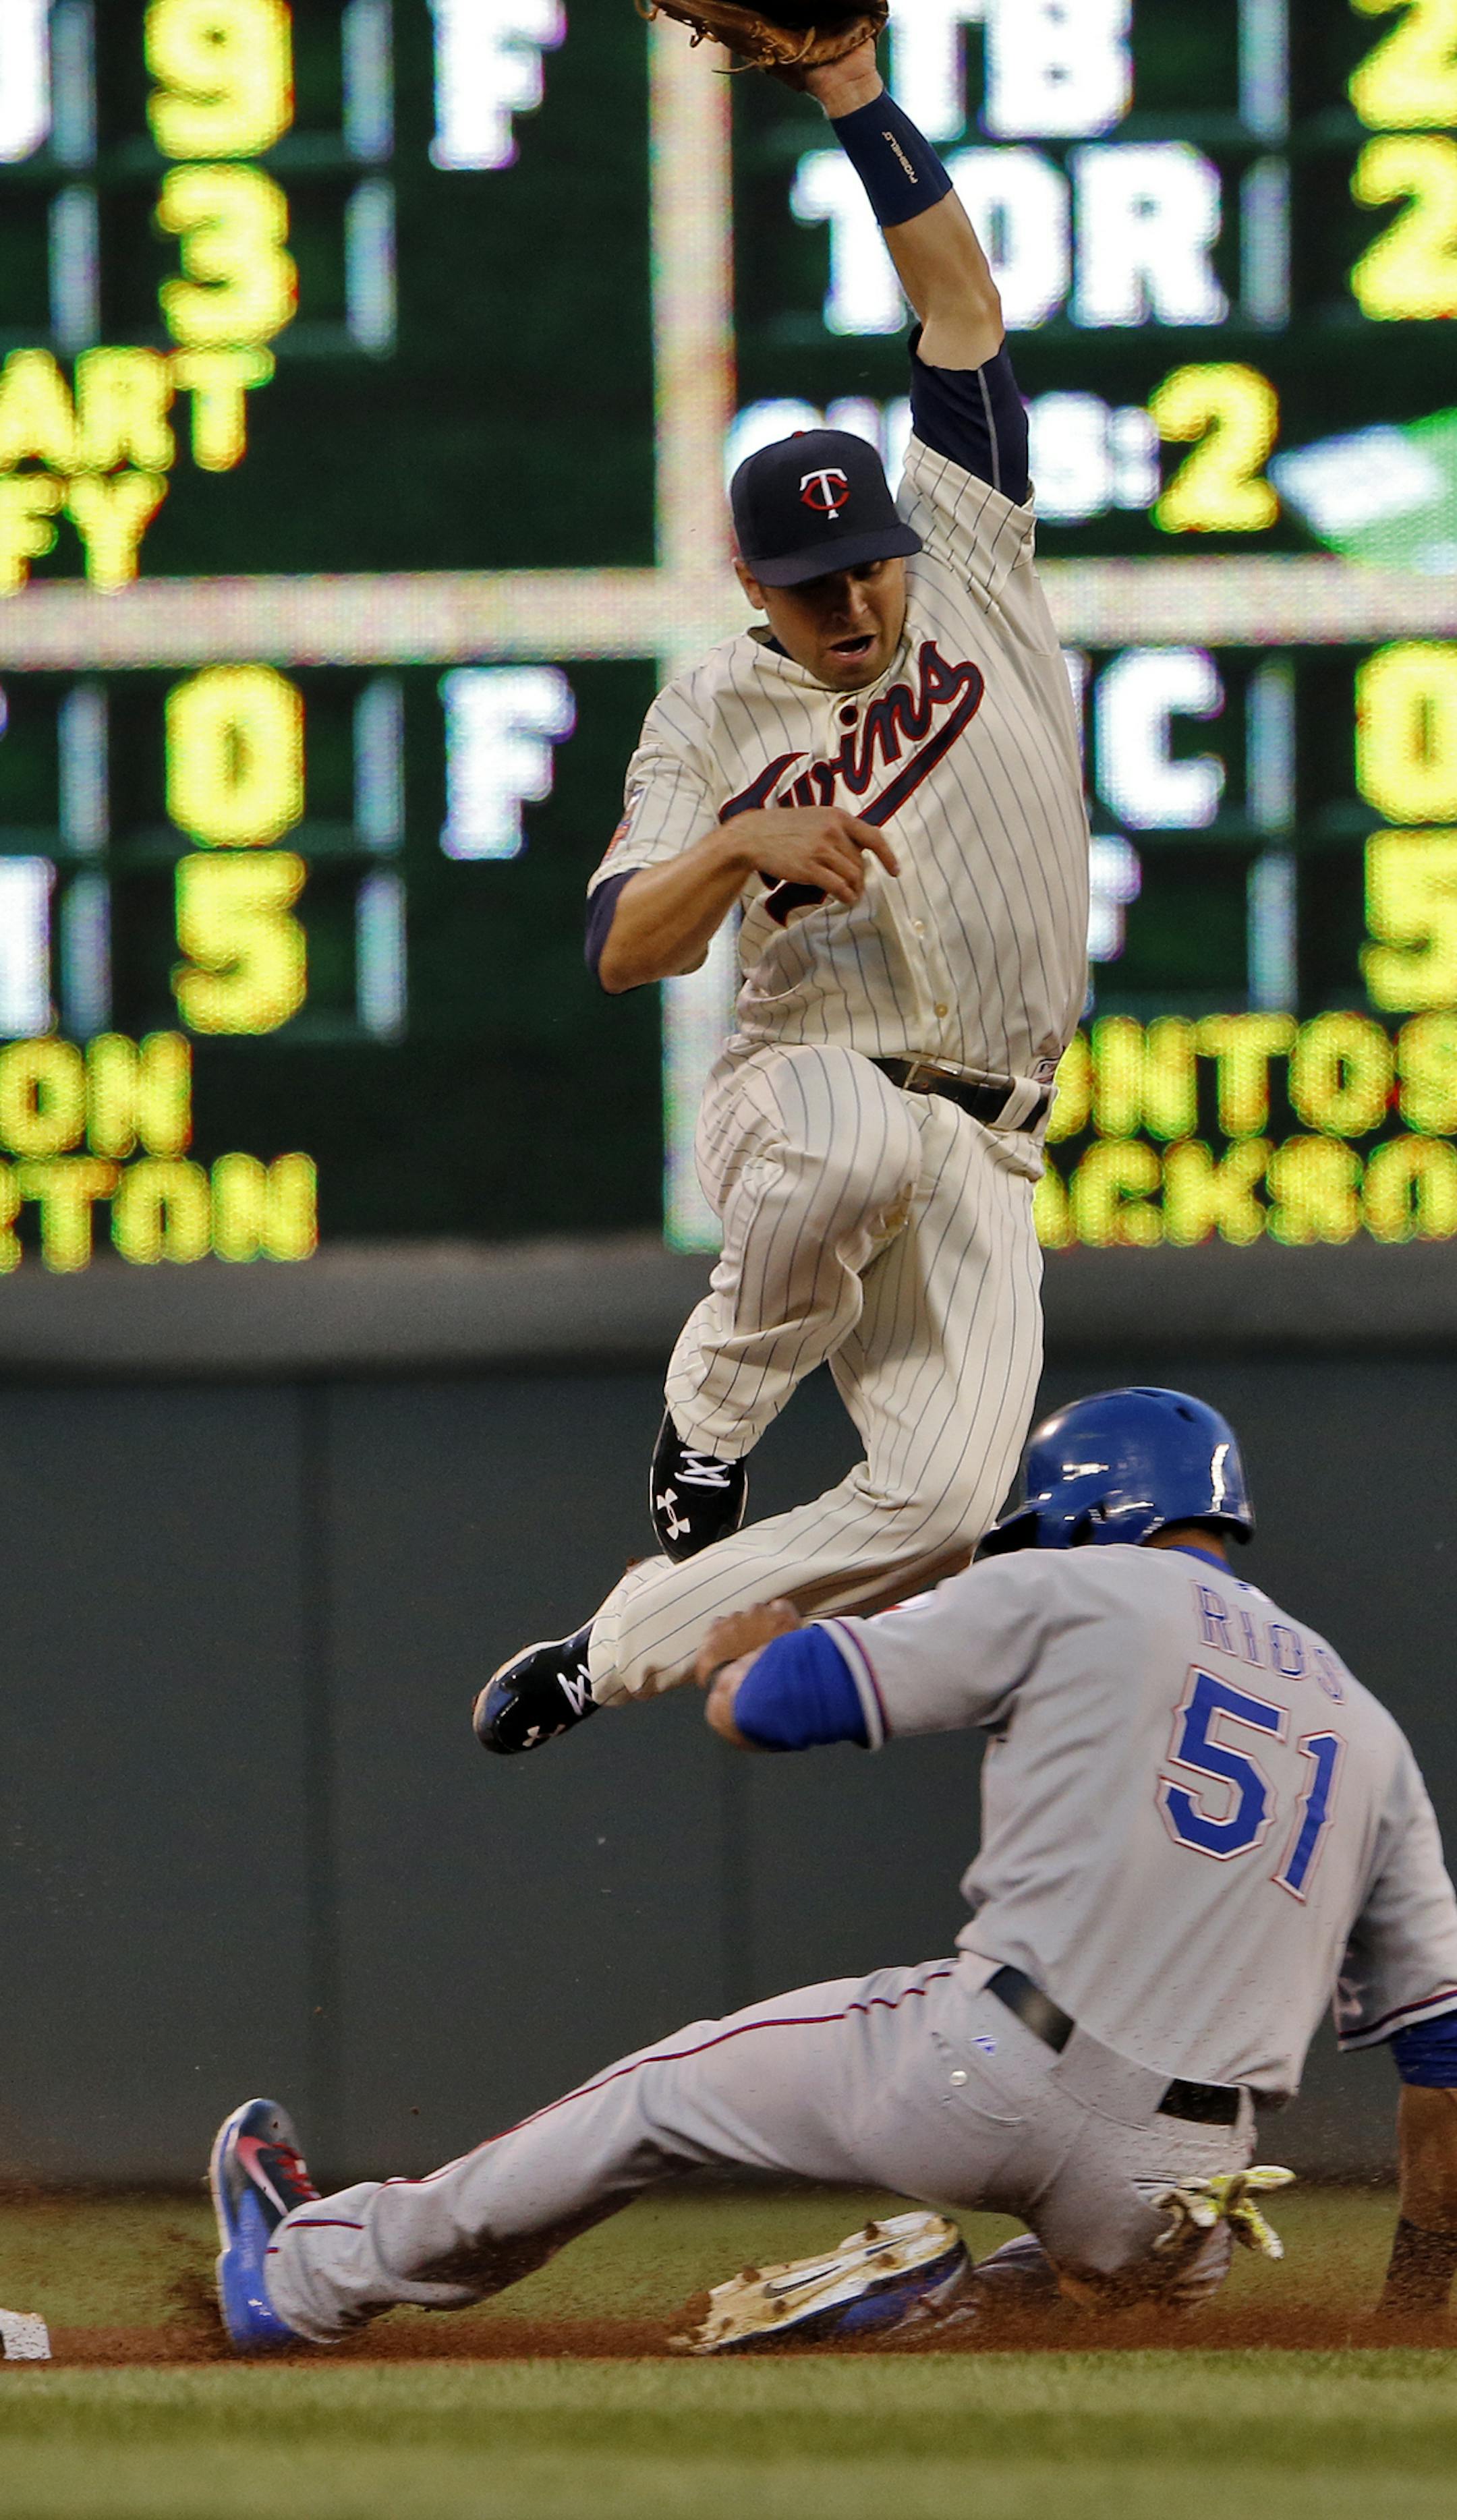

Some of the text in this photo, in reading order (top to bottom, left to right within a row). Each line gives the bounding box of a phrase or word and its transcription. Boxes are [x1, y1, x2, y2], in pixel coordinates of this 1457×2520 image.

[144, 0, 294, 160] 9
[428, 0, 567, 170] F
[156, 164, 298, 349] 3
[790, 136, 1457, 335] TOR 2
[1149, 363, 1279, 533] 2
[165, 664, 576, 860] 0 F
[171, 851, 308, 1034] 5
[1359, 828, 1457, 1013] 5
[0, 1152, 318, 1273] TON
[1189, 1579, 1347, 1705] RIOS
[1155, 1664, 1348, 1906] 51
